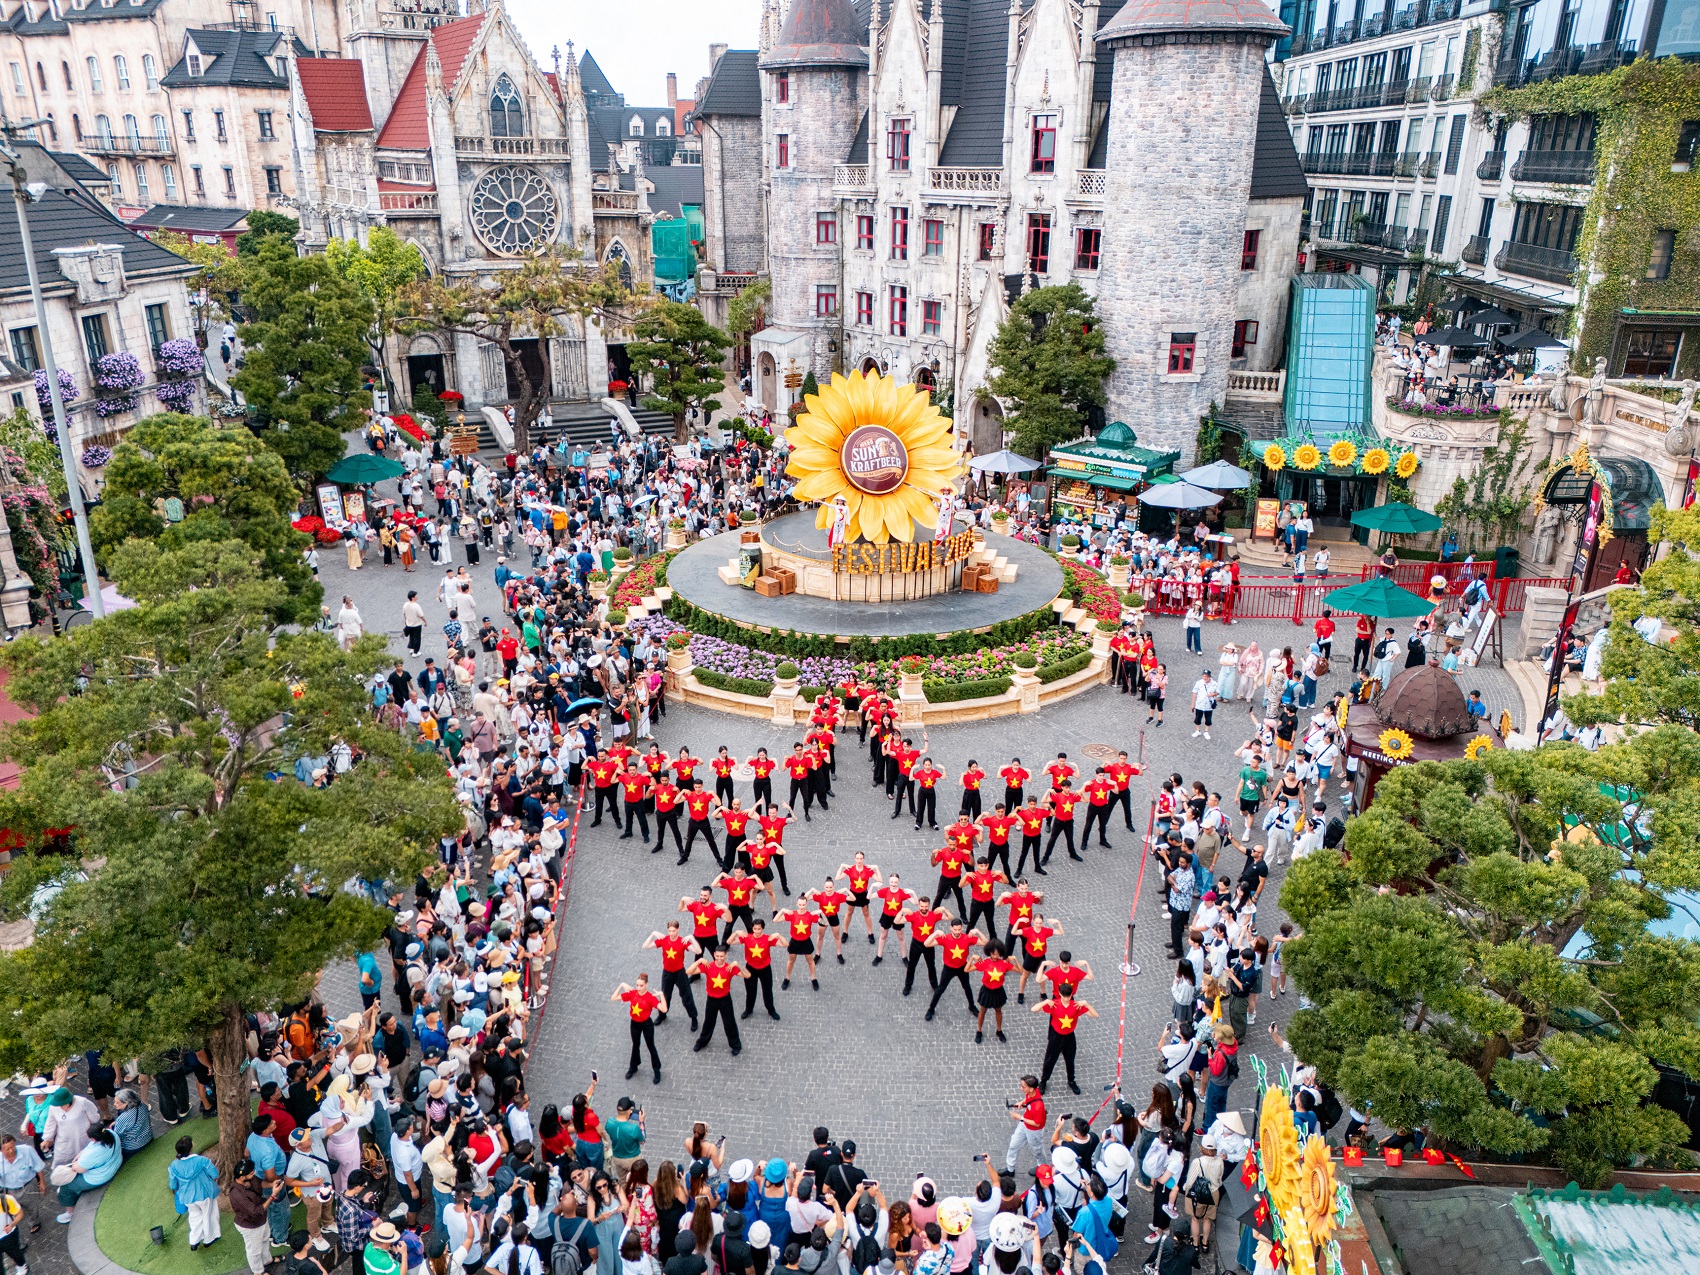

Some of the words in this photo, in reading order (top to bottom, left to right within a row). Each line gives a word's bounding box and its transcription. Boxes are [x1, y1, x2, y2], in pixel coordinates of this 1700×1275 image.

[852, 446, 878, 461] SUN
[850, 457, 902, 472] KRAFTBEER
[833, 540, 941, 575] FESTIVAL
[1362, 750, 1394, 764] MEETING
